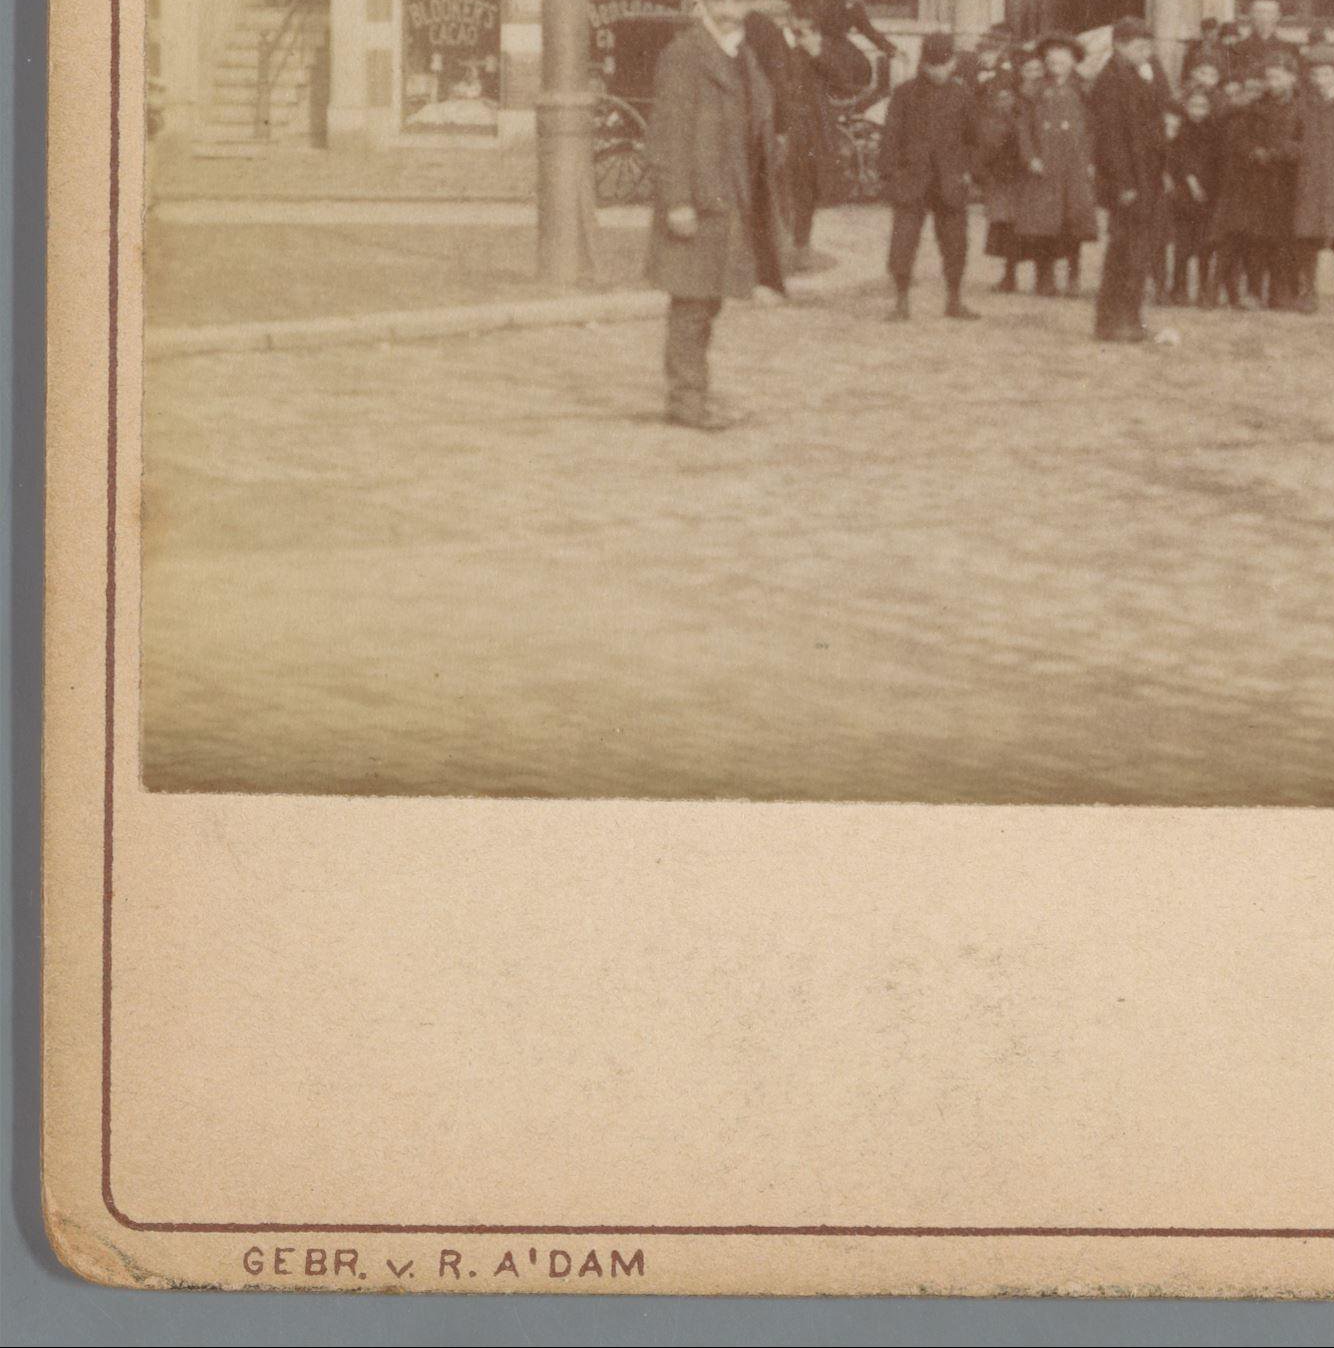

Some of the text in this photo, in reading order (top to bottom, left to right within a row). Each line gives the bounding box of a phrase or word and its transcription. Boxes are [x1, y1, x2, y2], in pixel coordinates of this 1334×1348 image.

[428, 22, 479, 47] CACAO
[242, 1246, 367, 1280] GEBR.
[438, 1249, 478, 1280] R.
[492, 1246, 646, 1279] A'DAM
